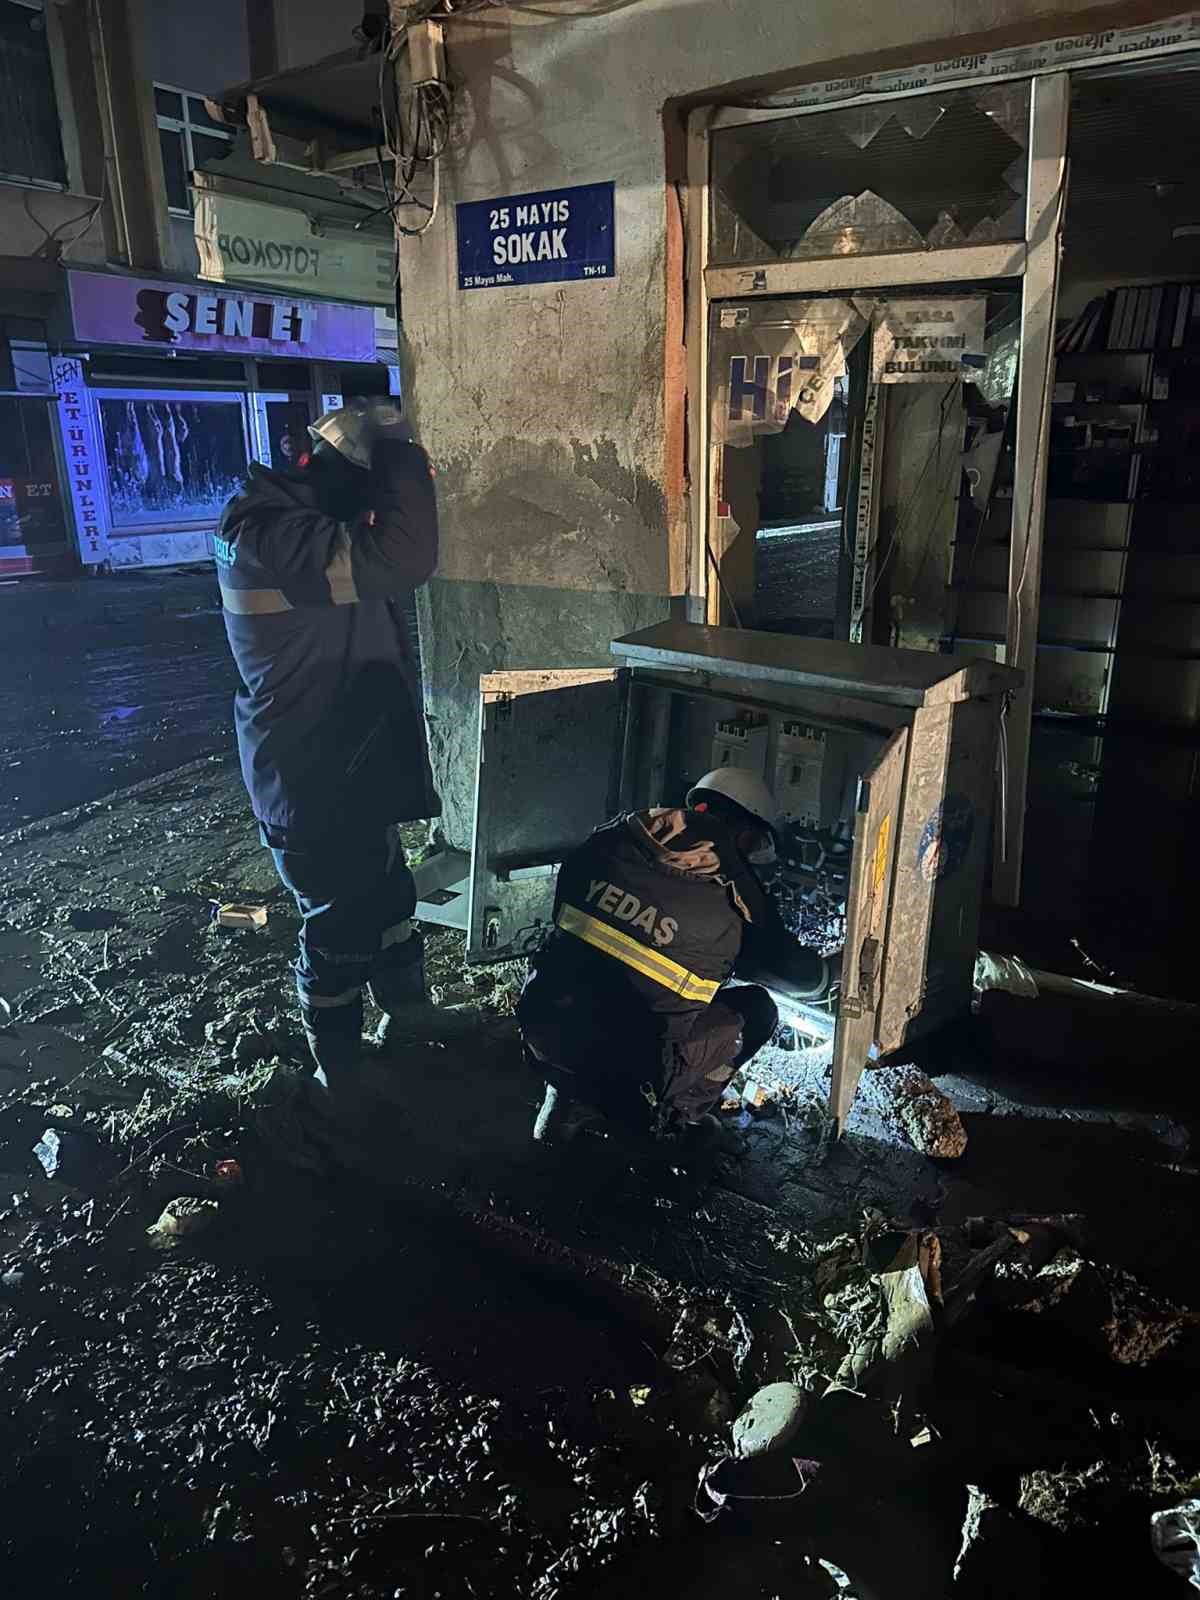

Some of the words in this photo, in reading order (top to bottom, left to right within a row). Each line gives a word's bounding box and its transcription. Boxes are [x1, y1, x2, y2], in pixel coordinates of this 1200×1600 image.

[1055, 31, 1115, 51] alfapen
[934, 55, 987, 70] alfapen
[489, 208, 510, 230] 25
[516, 200, 570, 227] MAYIS
[493, 228, 568, 265] SOKAK
[464, 278, 473, 287] 25
[496, 273, 514, 284] Mah.
[164, 292, 254, 343] ŞEN
[271, 300, 317, 343] ET
[885, 360, 961, 373] BULUNU
[328, 396, 338, 406] E
[25, 484, 52, 497] ET
